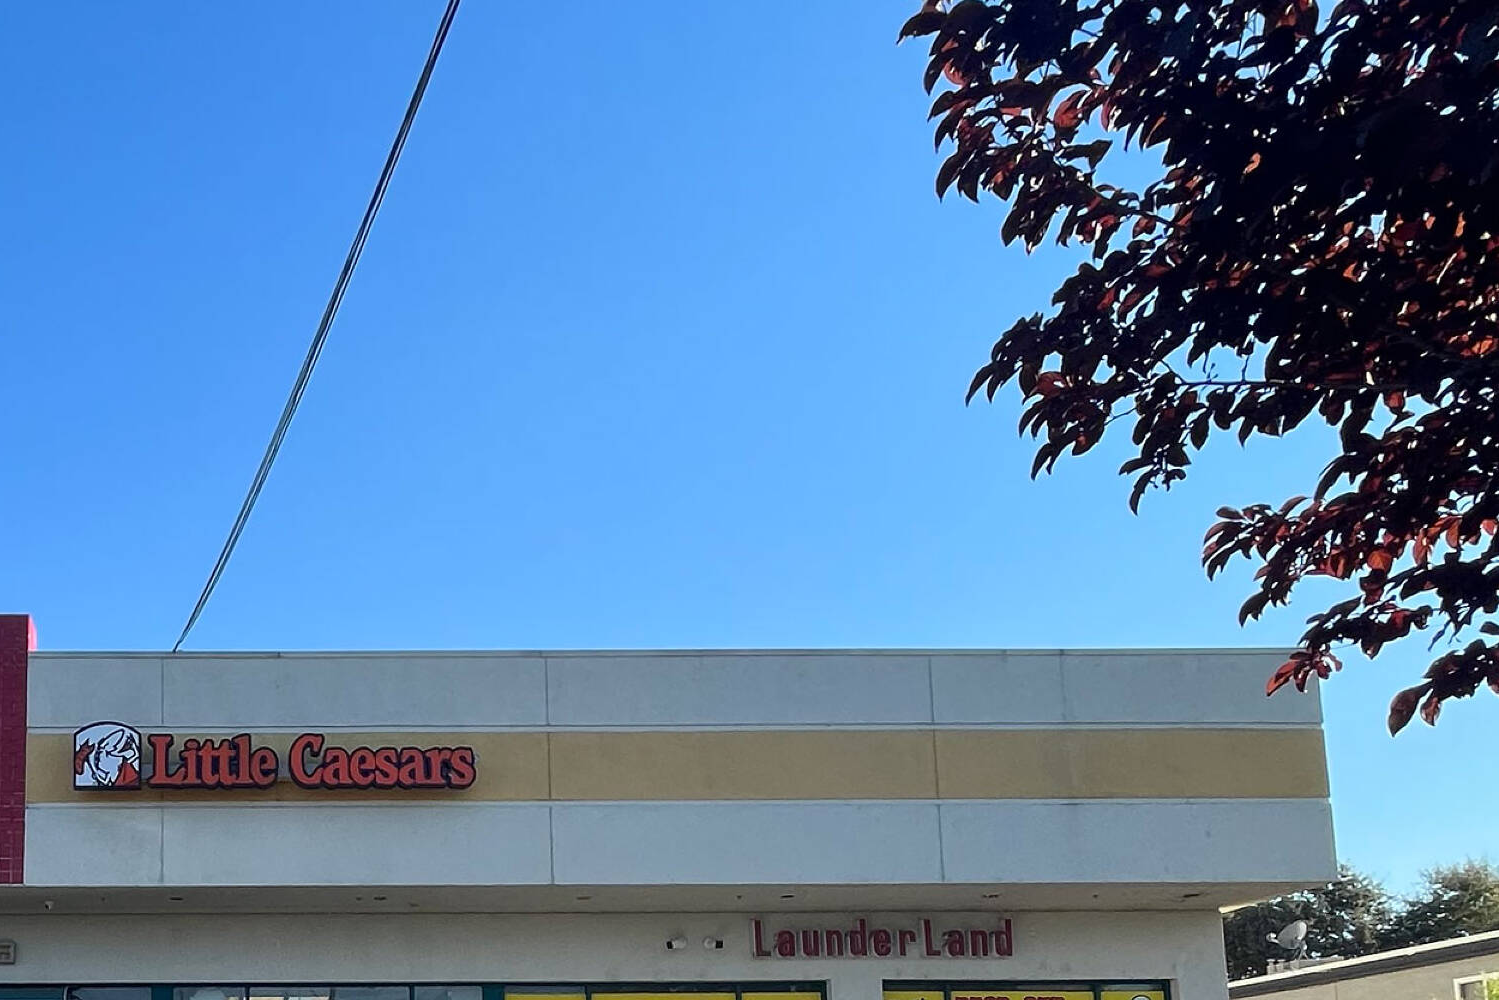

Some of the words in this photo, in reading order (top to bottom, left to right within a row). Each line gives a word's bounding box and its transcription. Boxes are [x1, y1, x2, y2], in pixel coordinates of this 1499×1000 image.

[147, 733, 278, 789] Little
[289, 733, 477, 789] Caesars
[751, 918, 1014, 959] LaunderLand
